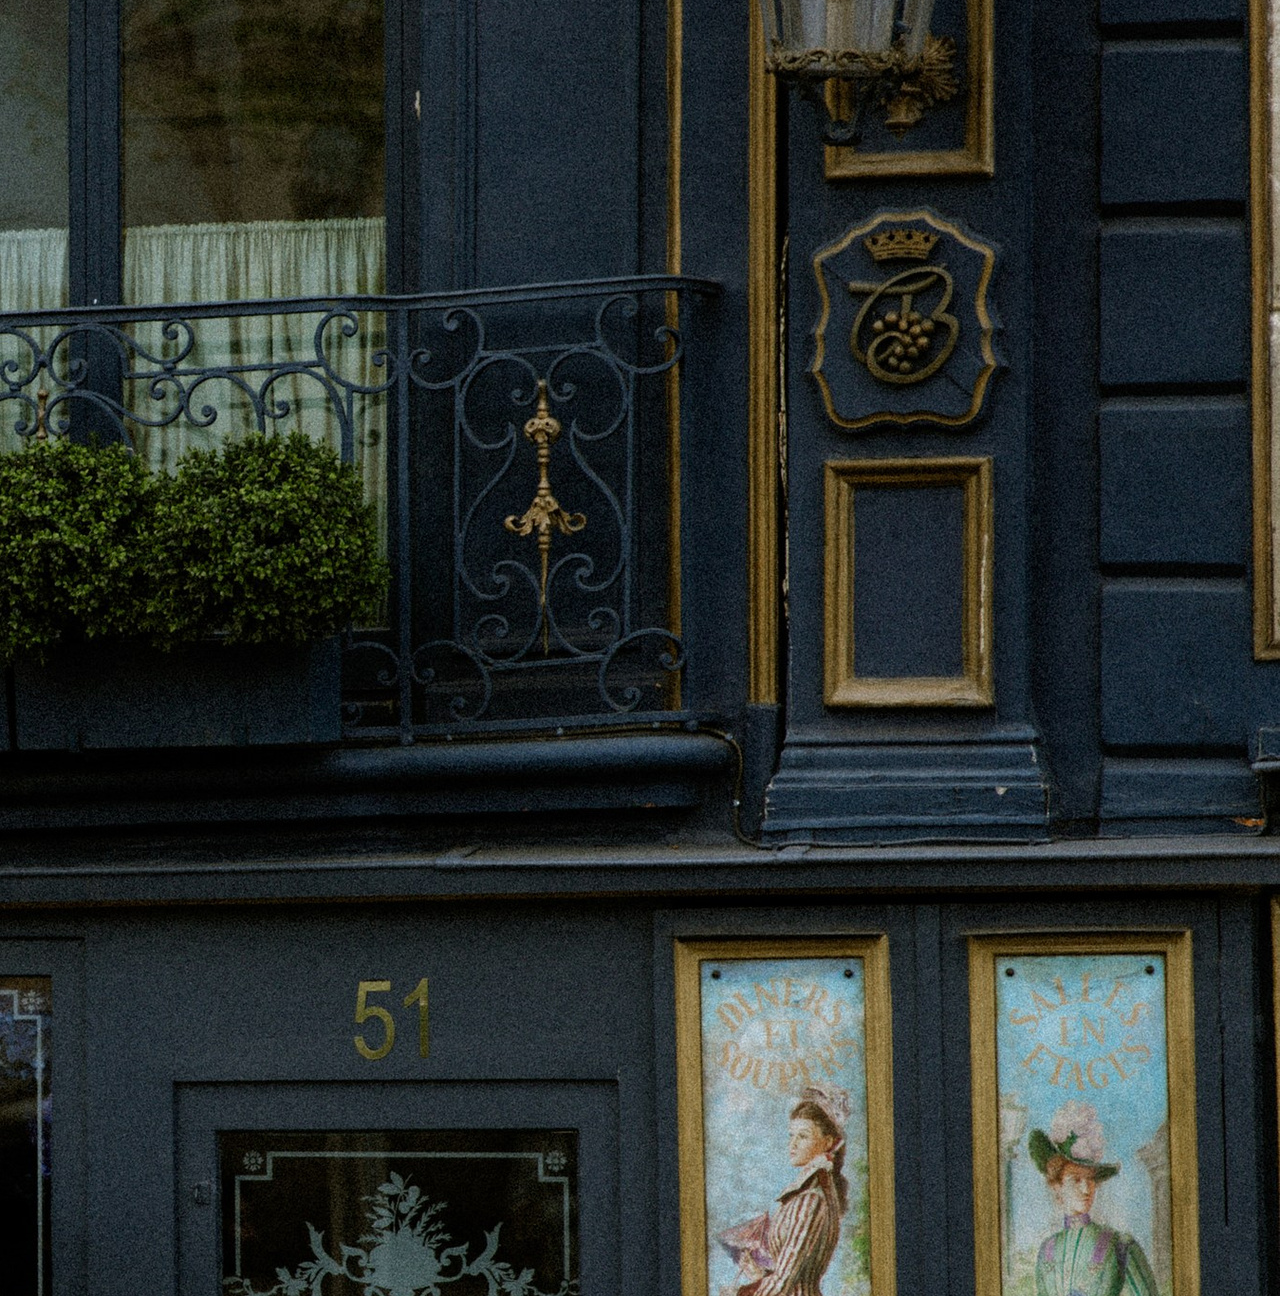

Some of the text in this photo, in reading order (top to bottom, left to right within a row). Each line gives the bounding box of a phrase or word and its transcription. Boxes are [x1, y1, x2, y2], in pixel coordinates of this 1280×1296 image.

[353, 977, 430, 1060] 51
[715, 976, 851, 1034] DINERS
[761, 1019, 804, 1051] ET
